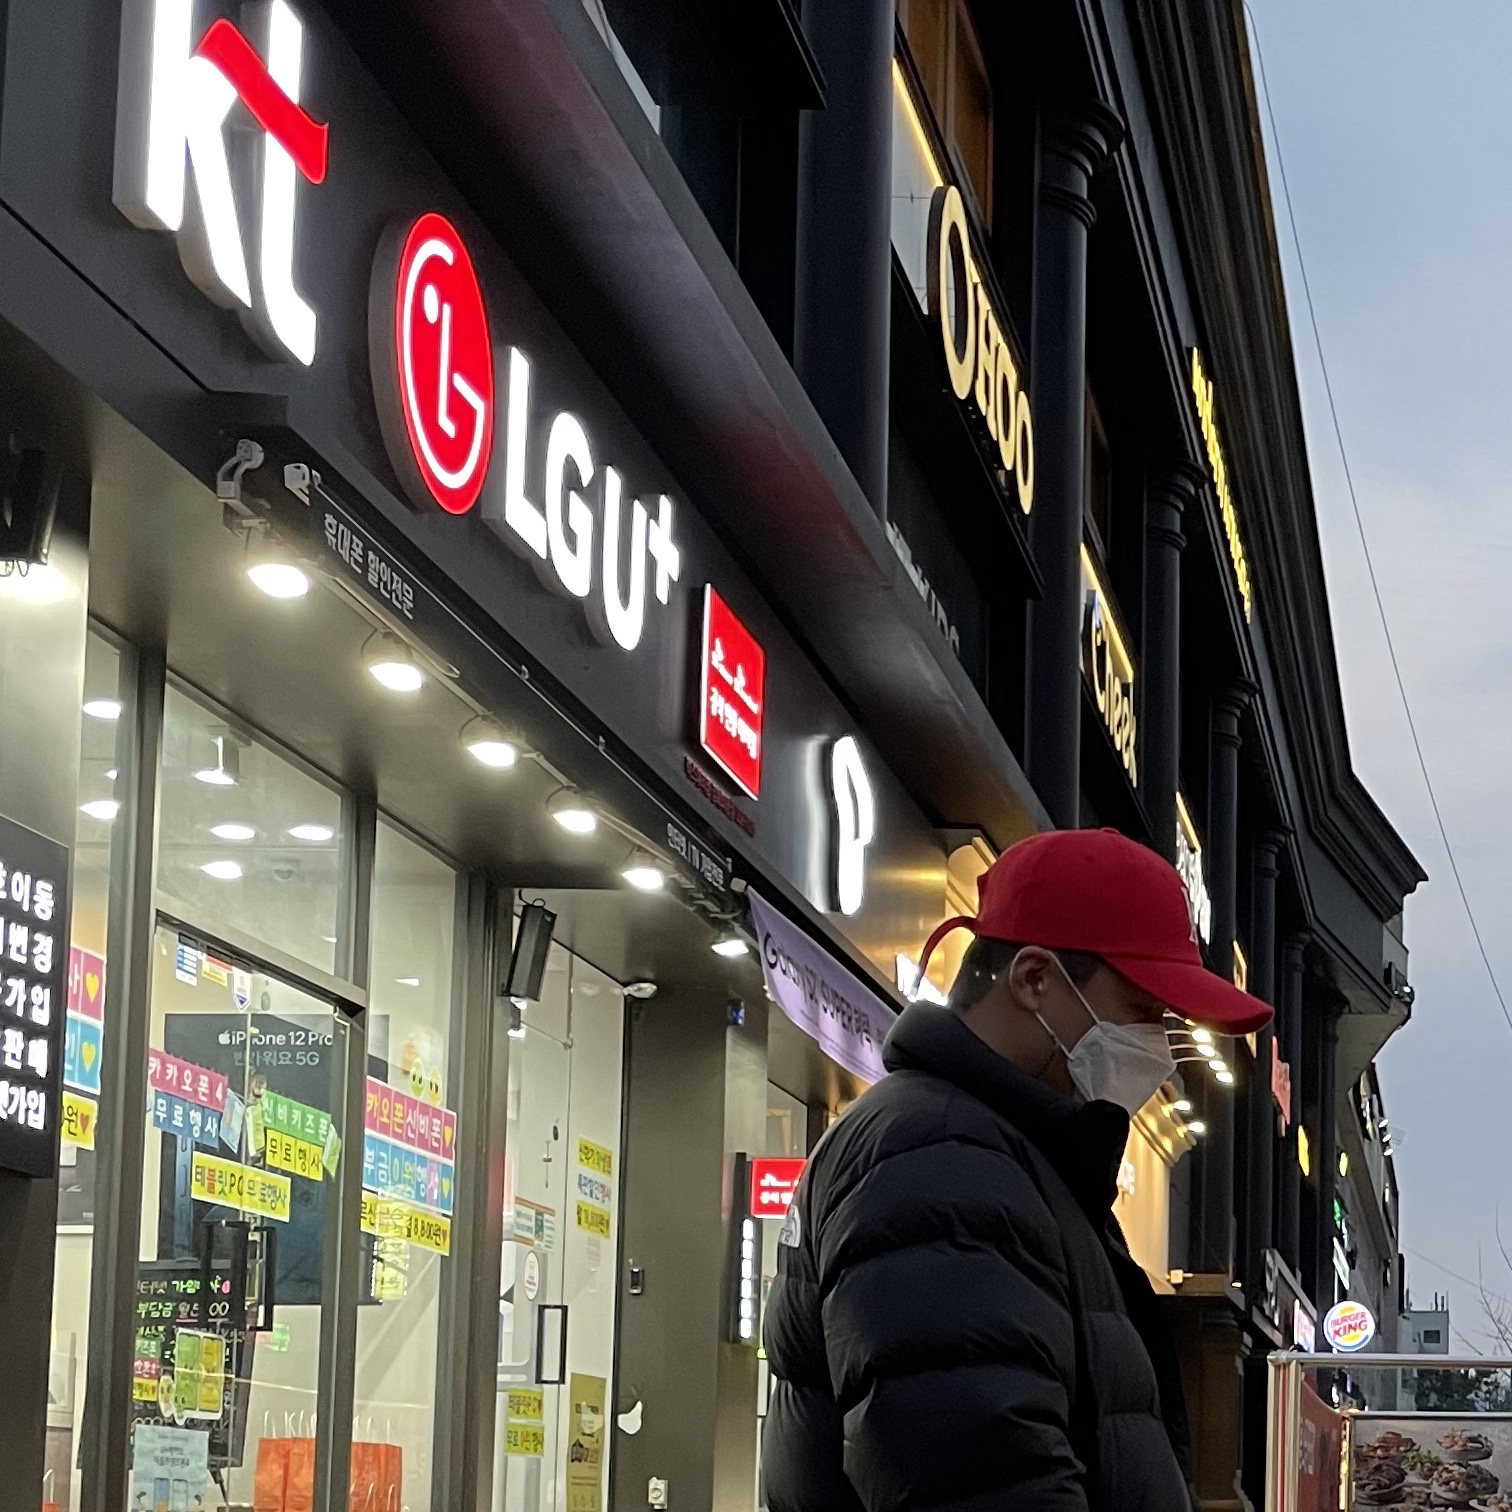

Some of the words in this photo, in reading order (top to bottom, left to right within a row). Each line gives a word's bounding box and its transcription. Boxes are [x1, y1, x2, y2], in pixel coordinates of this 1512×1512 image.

[324, 513, 364, 574] 휴대폰
[367, 551, 414, 620] 할인전문
[0, 916, 53, 974] 변경
[0, 972, 51, 1028] 가입
[288, 1031, 306, 1046] 12
[296, 1052, 320, 1066] 5G
[154, 1098, 219, 1138] 무료행사
[268, 1137, 322, 1176] 무료행사
[1330, 1311, 1369, 1328] BURGER
[1332, 1321, 1370, 1340] KING
